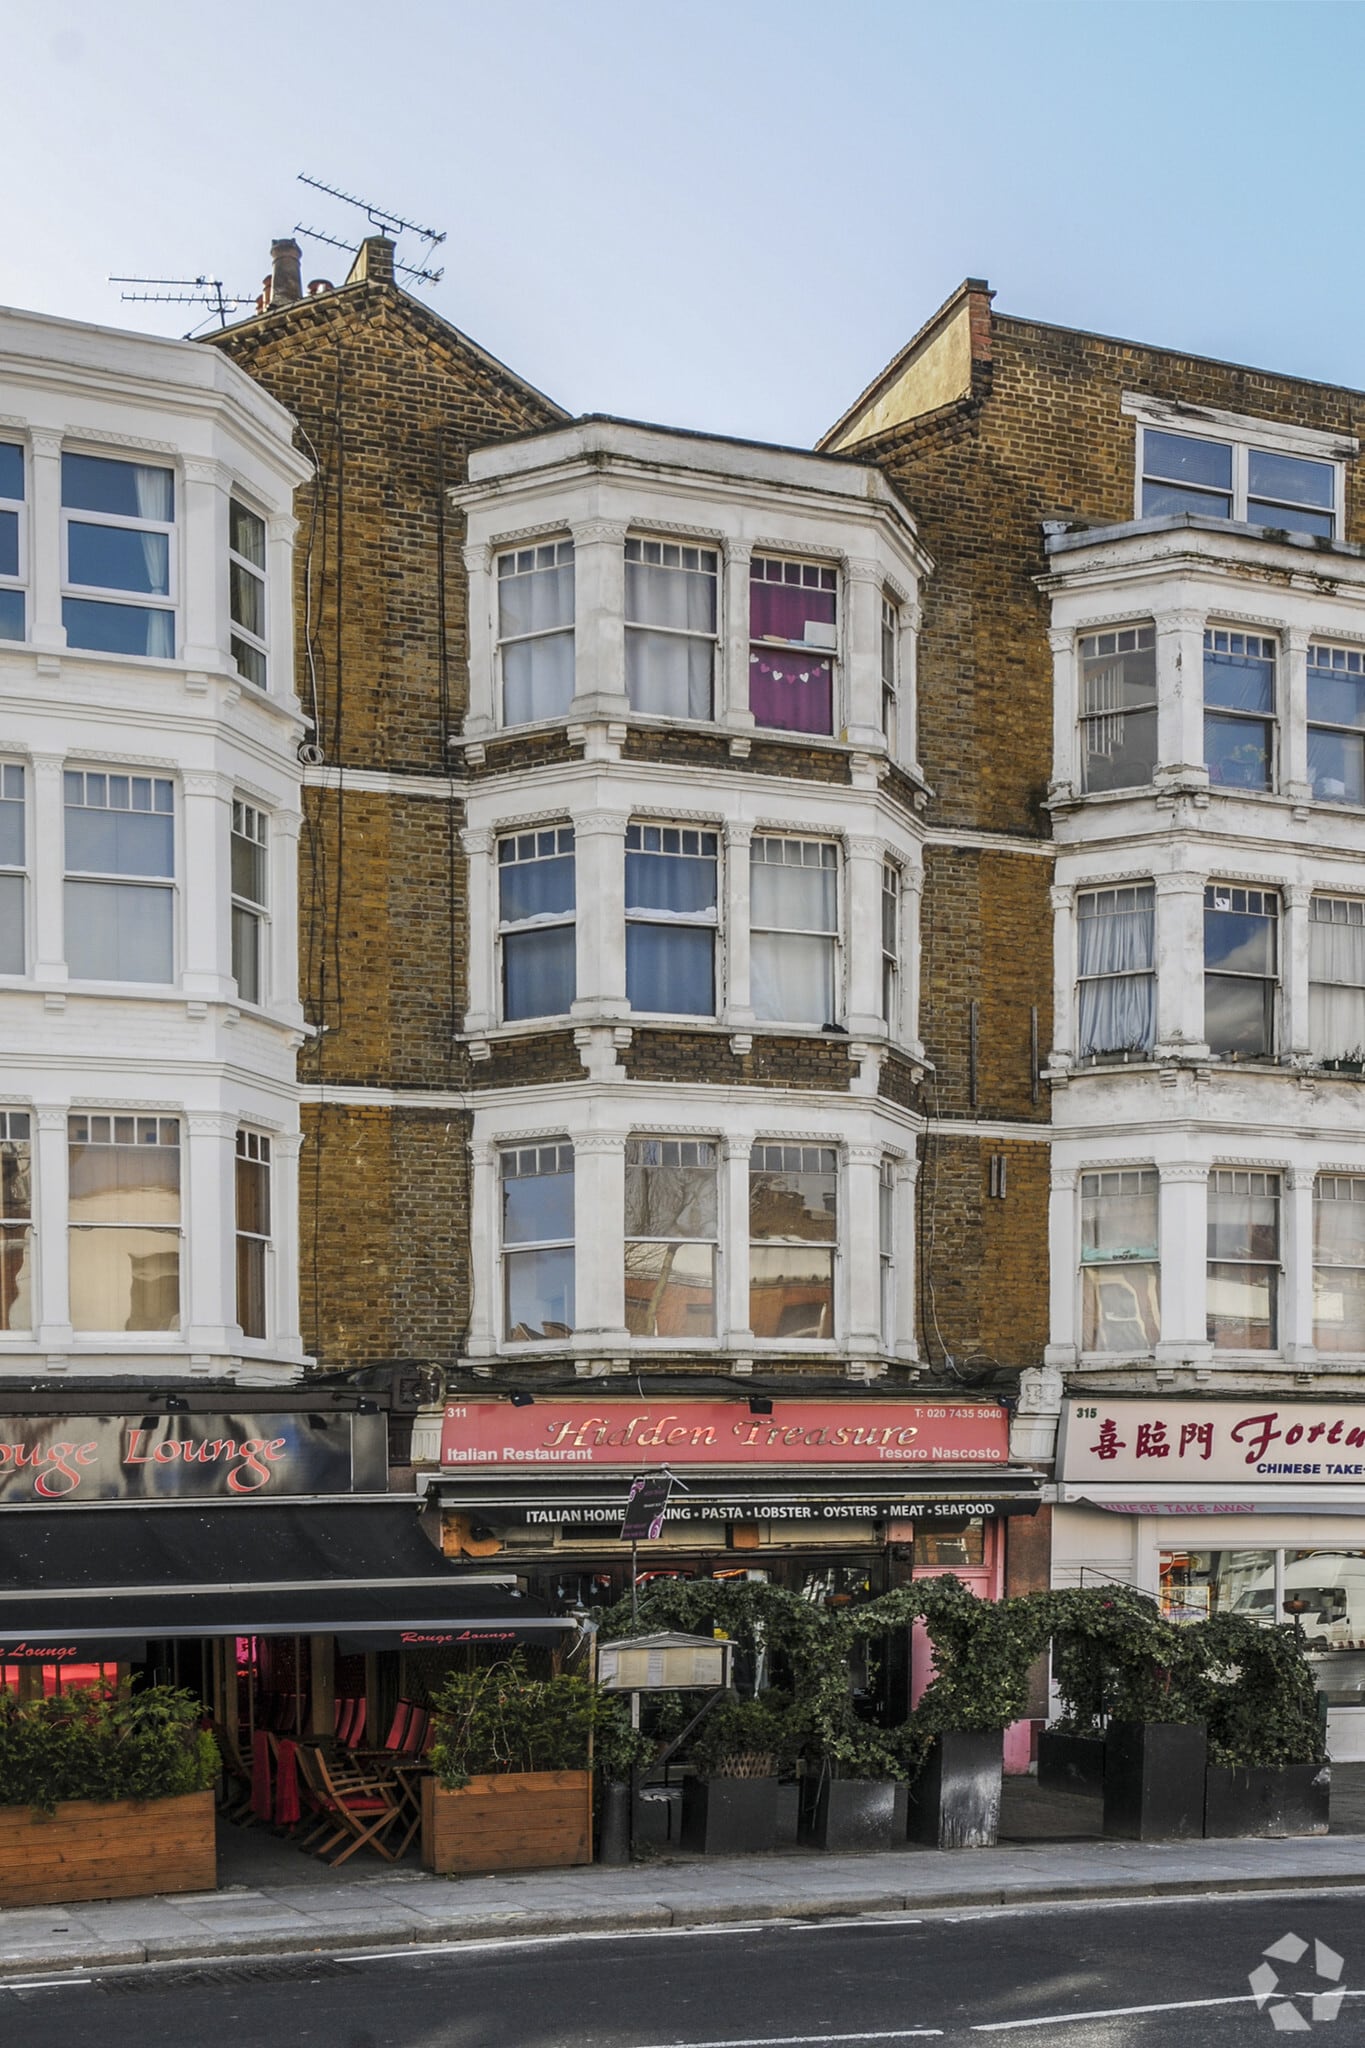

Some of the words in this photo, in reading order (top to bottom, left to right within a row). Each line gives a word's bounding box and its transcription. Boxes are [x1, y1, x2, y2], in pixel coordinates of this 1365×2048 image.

[447, 1407, 467, 1418] 311
[927, 1408, 946, 1419] 020
[949, 1408, 975, 1418] 7435
[977, 1408, 1002, 1418] 5040
[1076, 1407, 1097, 1419] 315
[543, 1415, 718, 1448] Hidden
[733, 1418, 919, 1446] Treasure
[1089, 1418, 1215, 1460] 喜臨門
[447, 1448, 497, 1461] Italian
[503, 1447, 593, 1461] Restaurant
[877, 1447, 928, 1459] Tesoro
[932, 1446, 1001, 1459] Nascosto
[123, 1429, 286, 1493] Lounge
[1256, 1463, 1321, 1474] CHINESE
[526, 1510, 586, 1523] ITALIAN
[588, 1509, 626, 1521] HOME
[702, 1507, 743, 1520] PASTA
[754, 1506, 811, 1519] LOBSTER
[823, 1505, 878, 1518] OYSTERS
[890, 1504, 925, 1517] MEAT
[934, 1503, 995, 1516] SEAFOOD
[1165, 1503, 1256, 1513] TAKE-AWAY
[400, 1631, 454, 1644] Rouge
[456, 1630, 516, 1641] Lounge
[8, 1642, 78, 1660] Lounge
